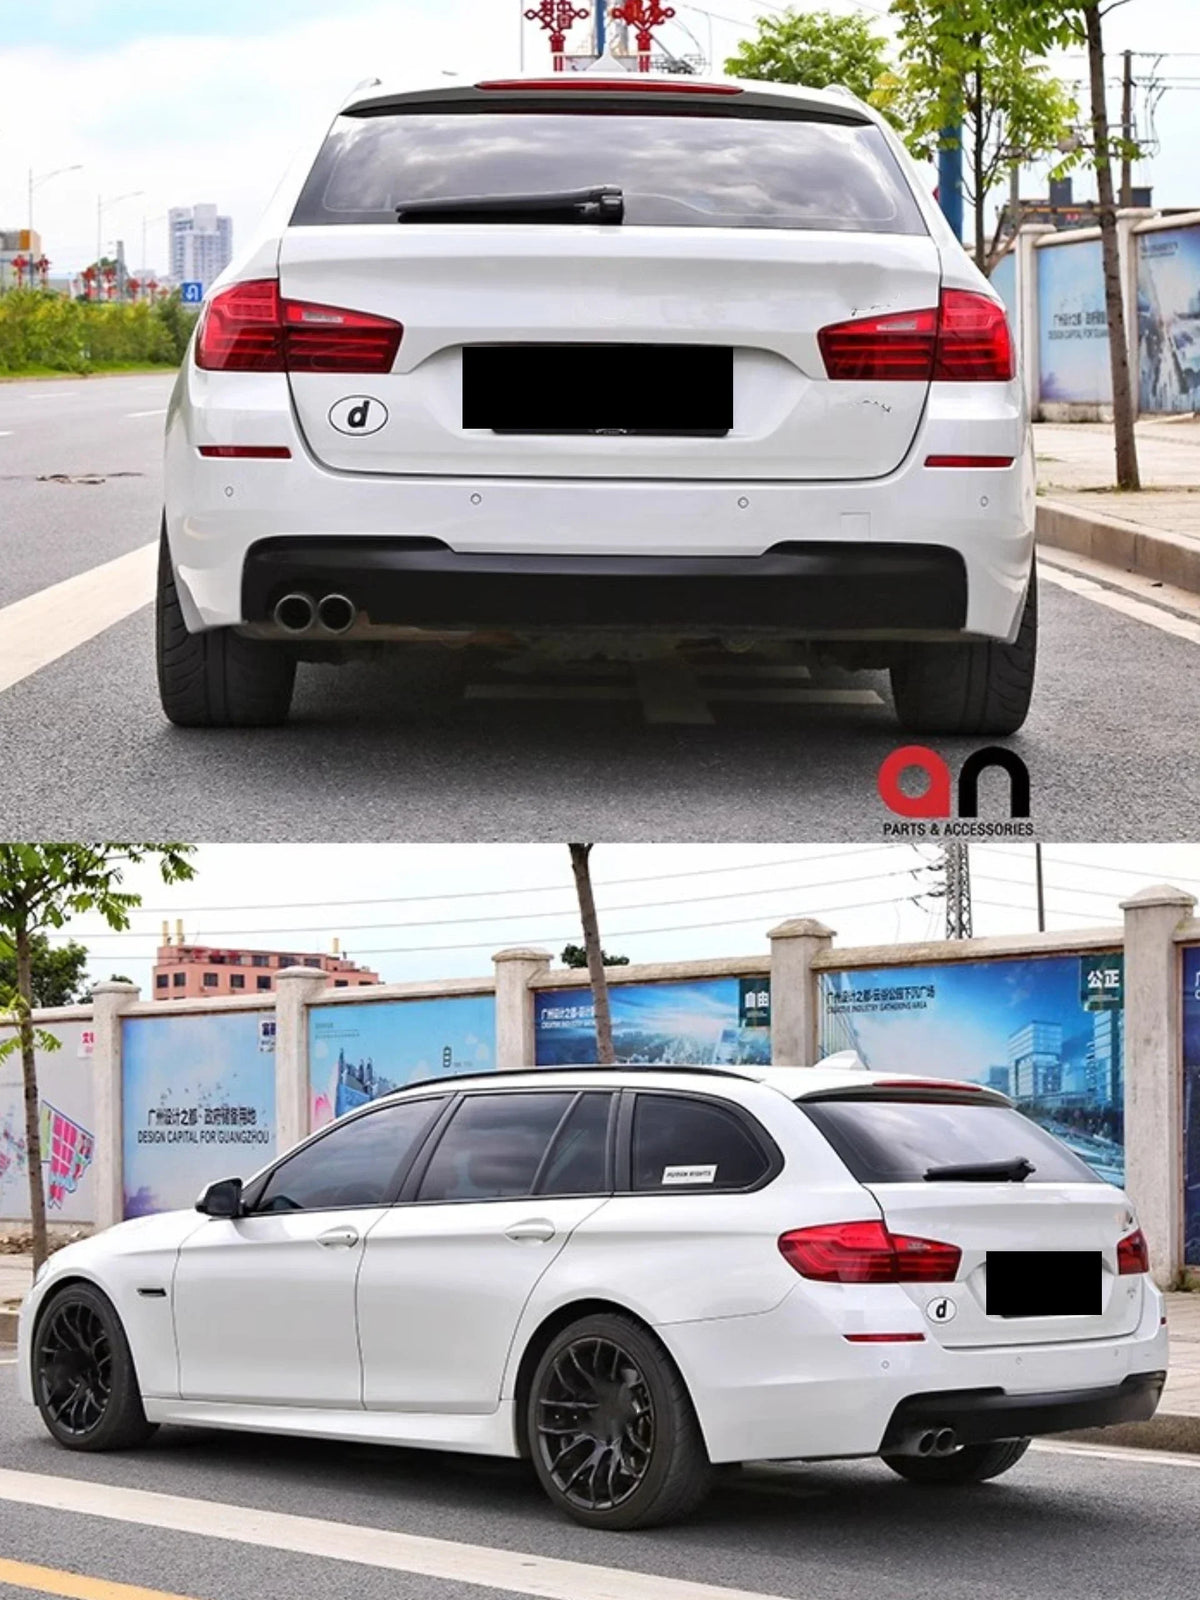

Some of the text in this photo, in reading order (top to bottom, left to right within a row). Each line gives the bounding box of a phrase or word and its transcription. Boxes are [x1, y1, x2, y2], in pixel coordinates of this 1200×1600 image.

[347, 399, 370, 428] d
[1087, 969, 1120, 989] 公正
[744, 990, 770, 1008] 自由
[138, 1130, 269, 1144] DESIGN CAPITAL FOR GUANGZHOU
[935, 1299, 947, 1319] d
